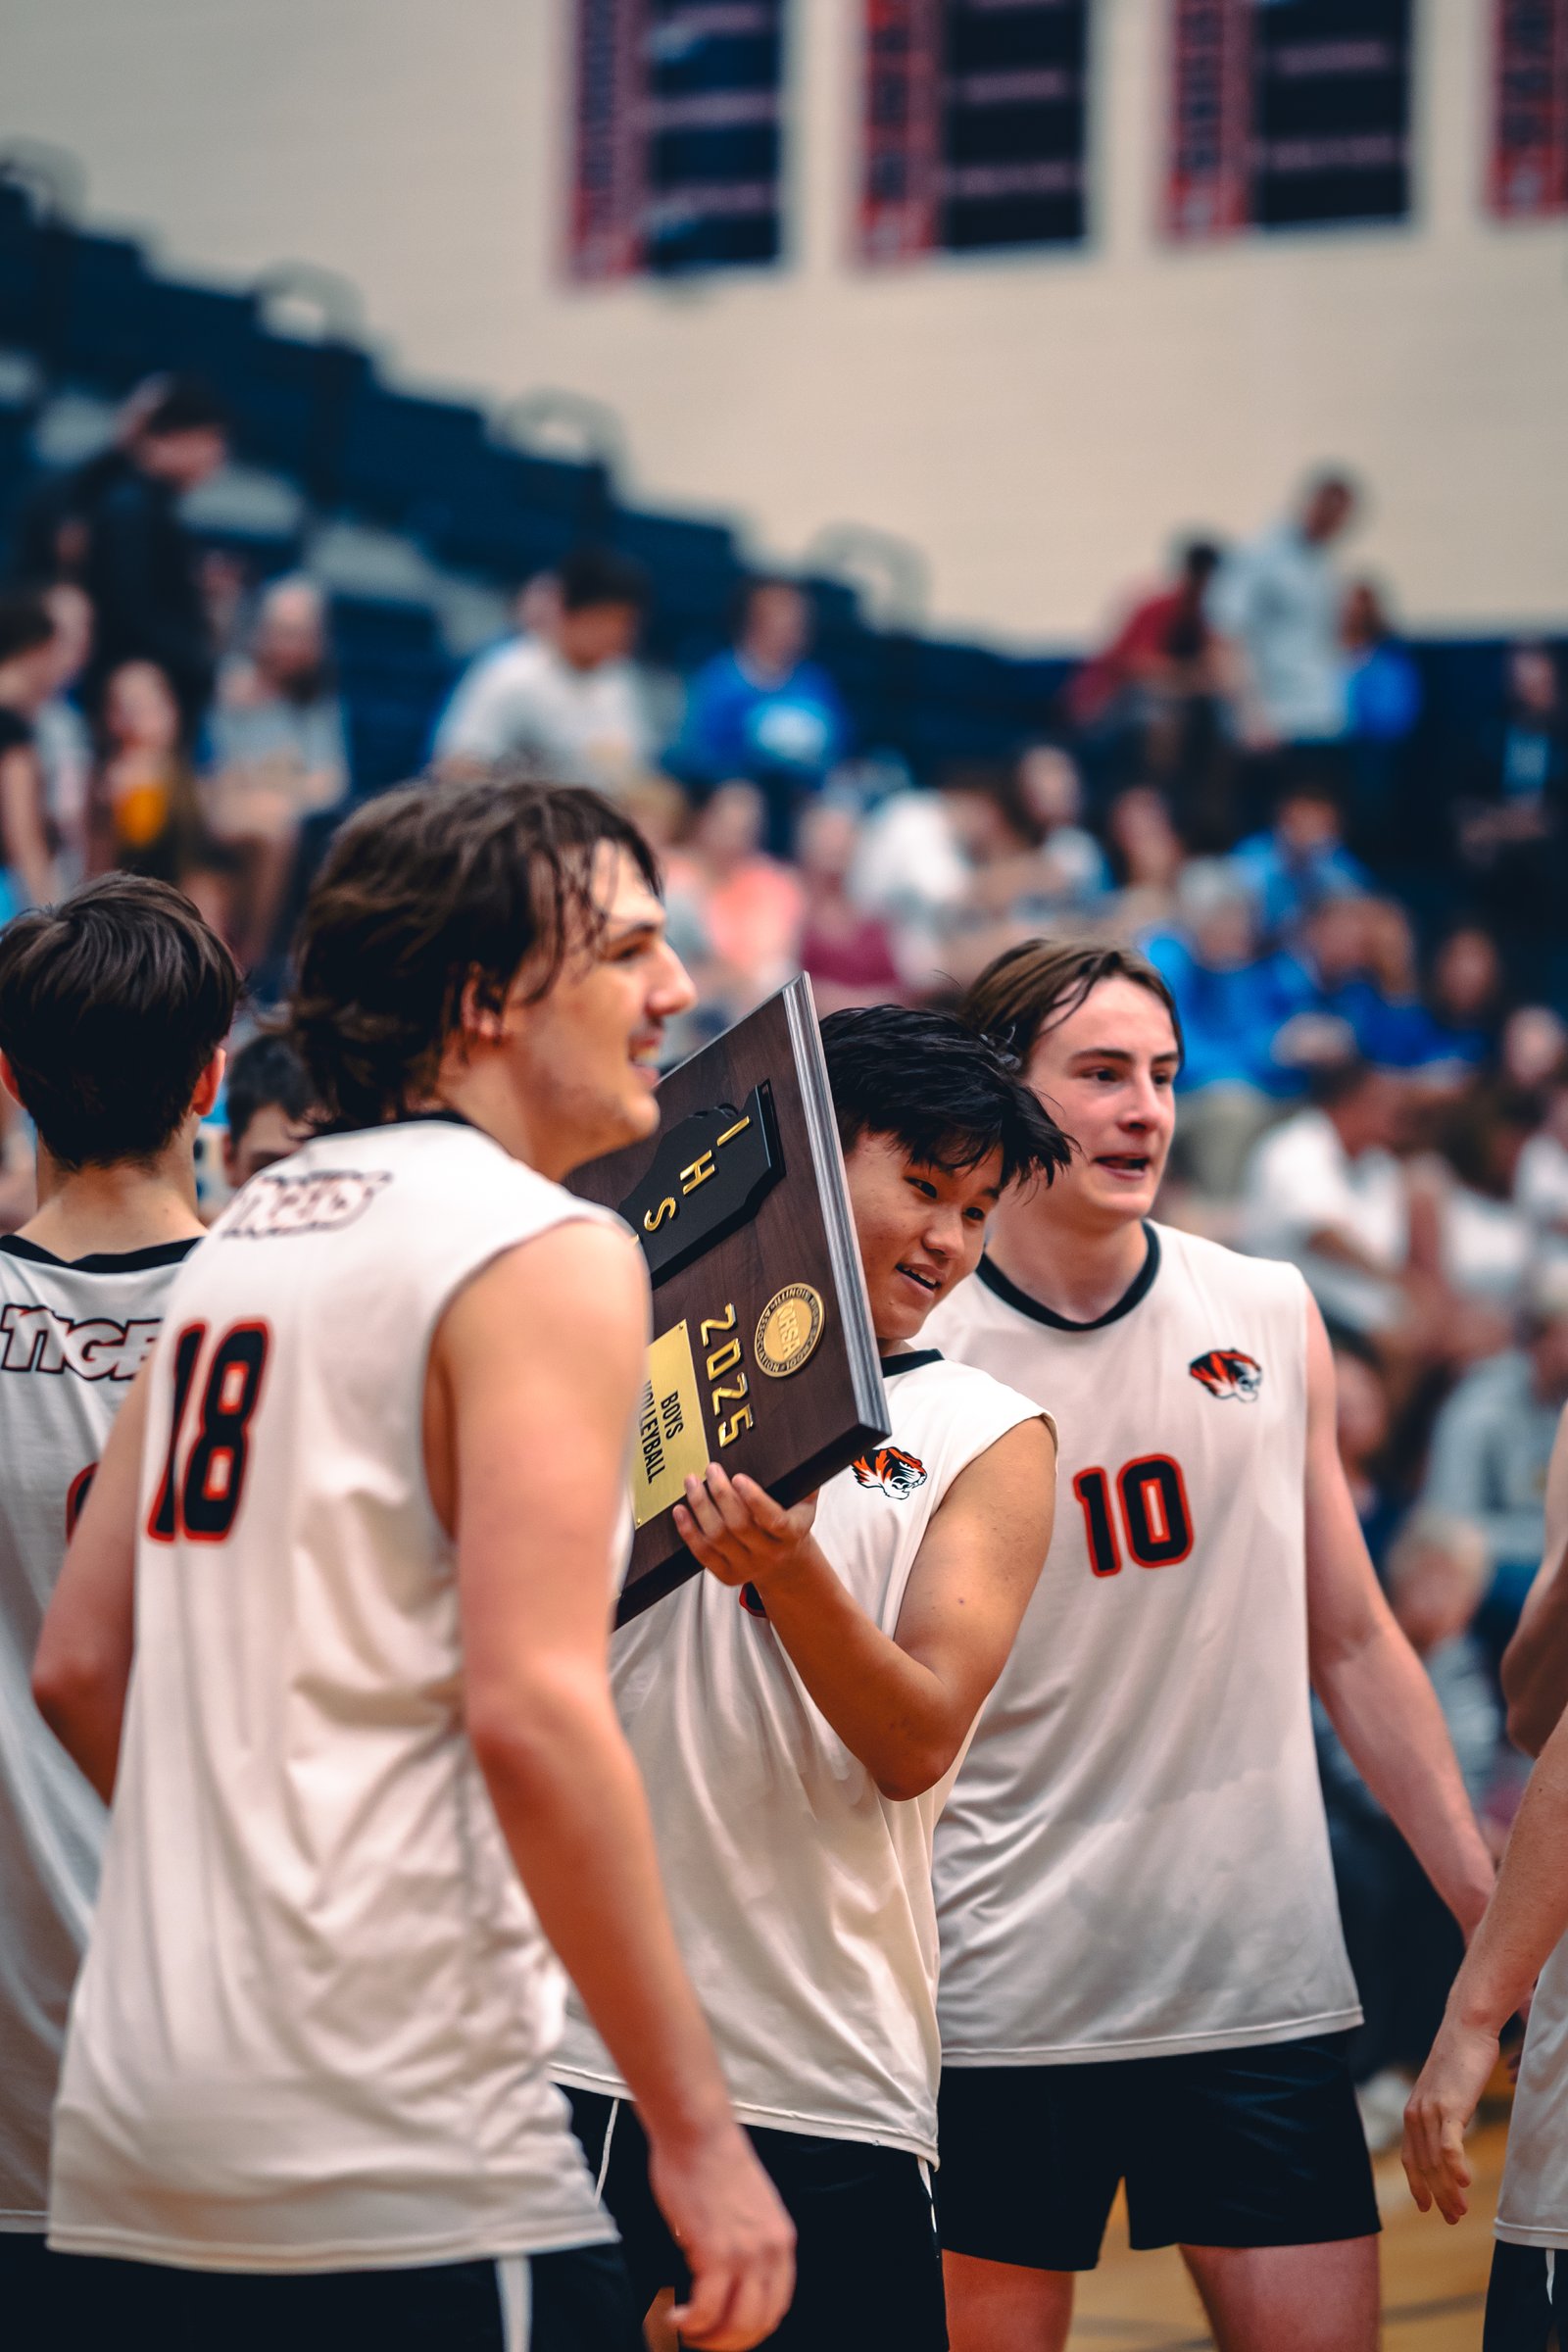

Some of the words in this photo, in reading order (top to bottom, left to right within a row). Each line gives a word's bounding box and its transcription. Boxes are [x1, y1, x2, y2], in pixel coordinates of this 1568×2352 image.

[636, 1115, 751, 1241] IHS
[147, 1321, 270, 1543] 18
[661, 1389, 684, 1440] BOYS
[701, 1303, 754, 1447] 2025
[1073, 1452, 1194, 1578] 10
